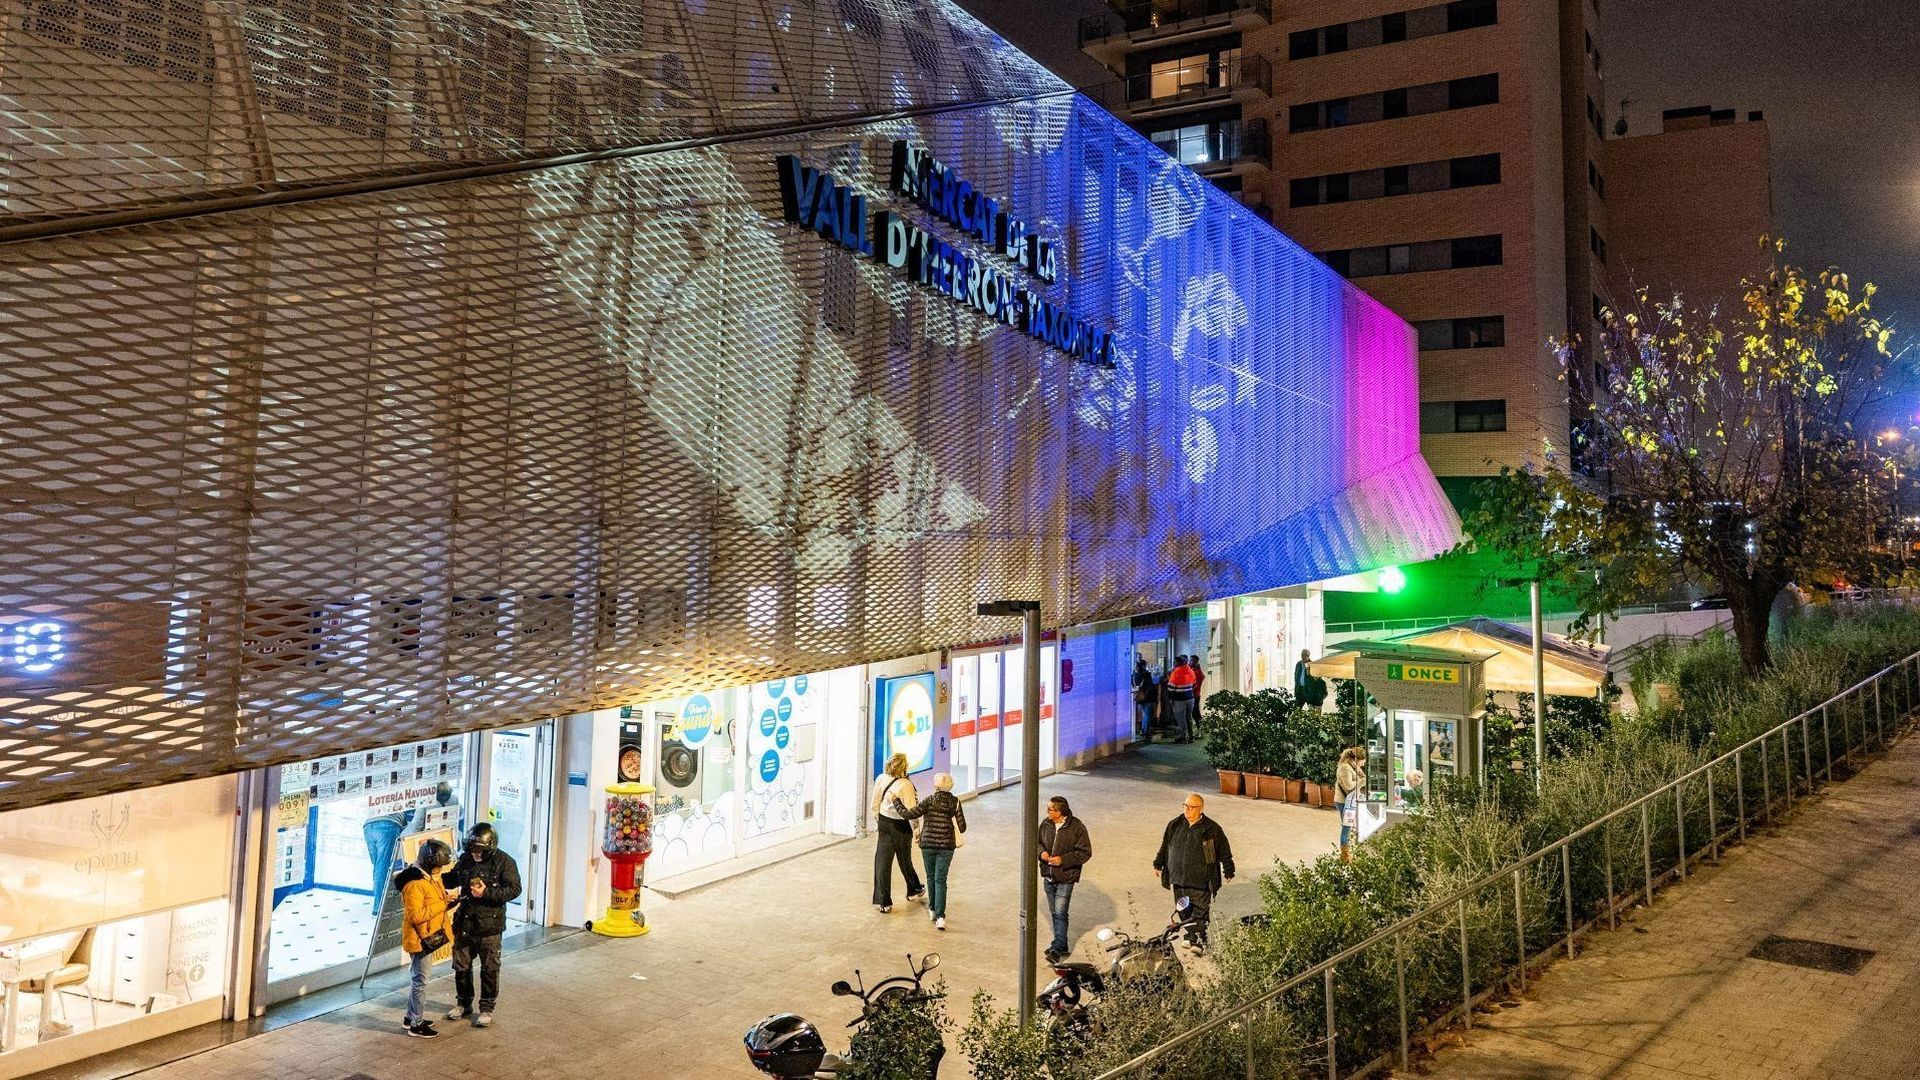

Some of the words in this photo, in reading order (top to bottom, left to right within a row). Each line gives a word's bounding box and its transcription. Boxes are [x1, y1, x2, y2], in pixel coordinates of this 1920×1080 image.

[778, 154, 873, 256] VALL
[892, 140, 999, 245] MERCAT
[1408, 668, 1452, 681] ONCE
[894, 710, 931, 737] LIDL
[405, 786, 437, 800] NAVIDAD
